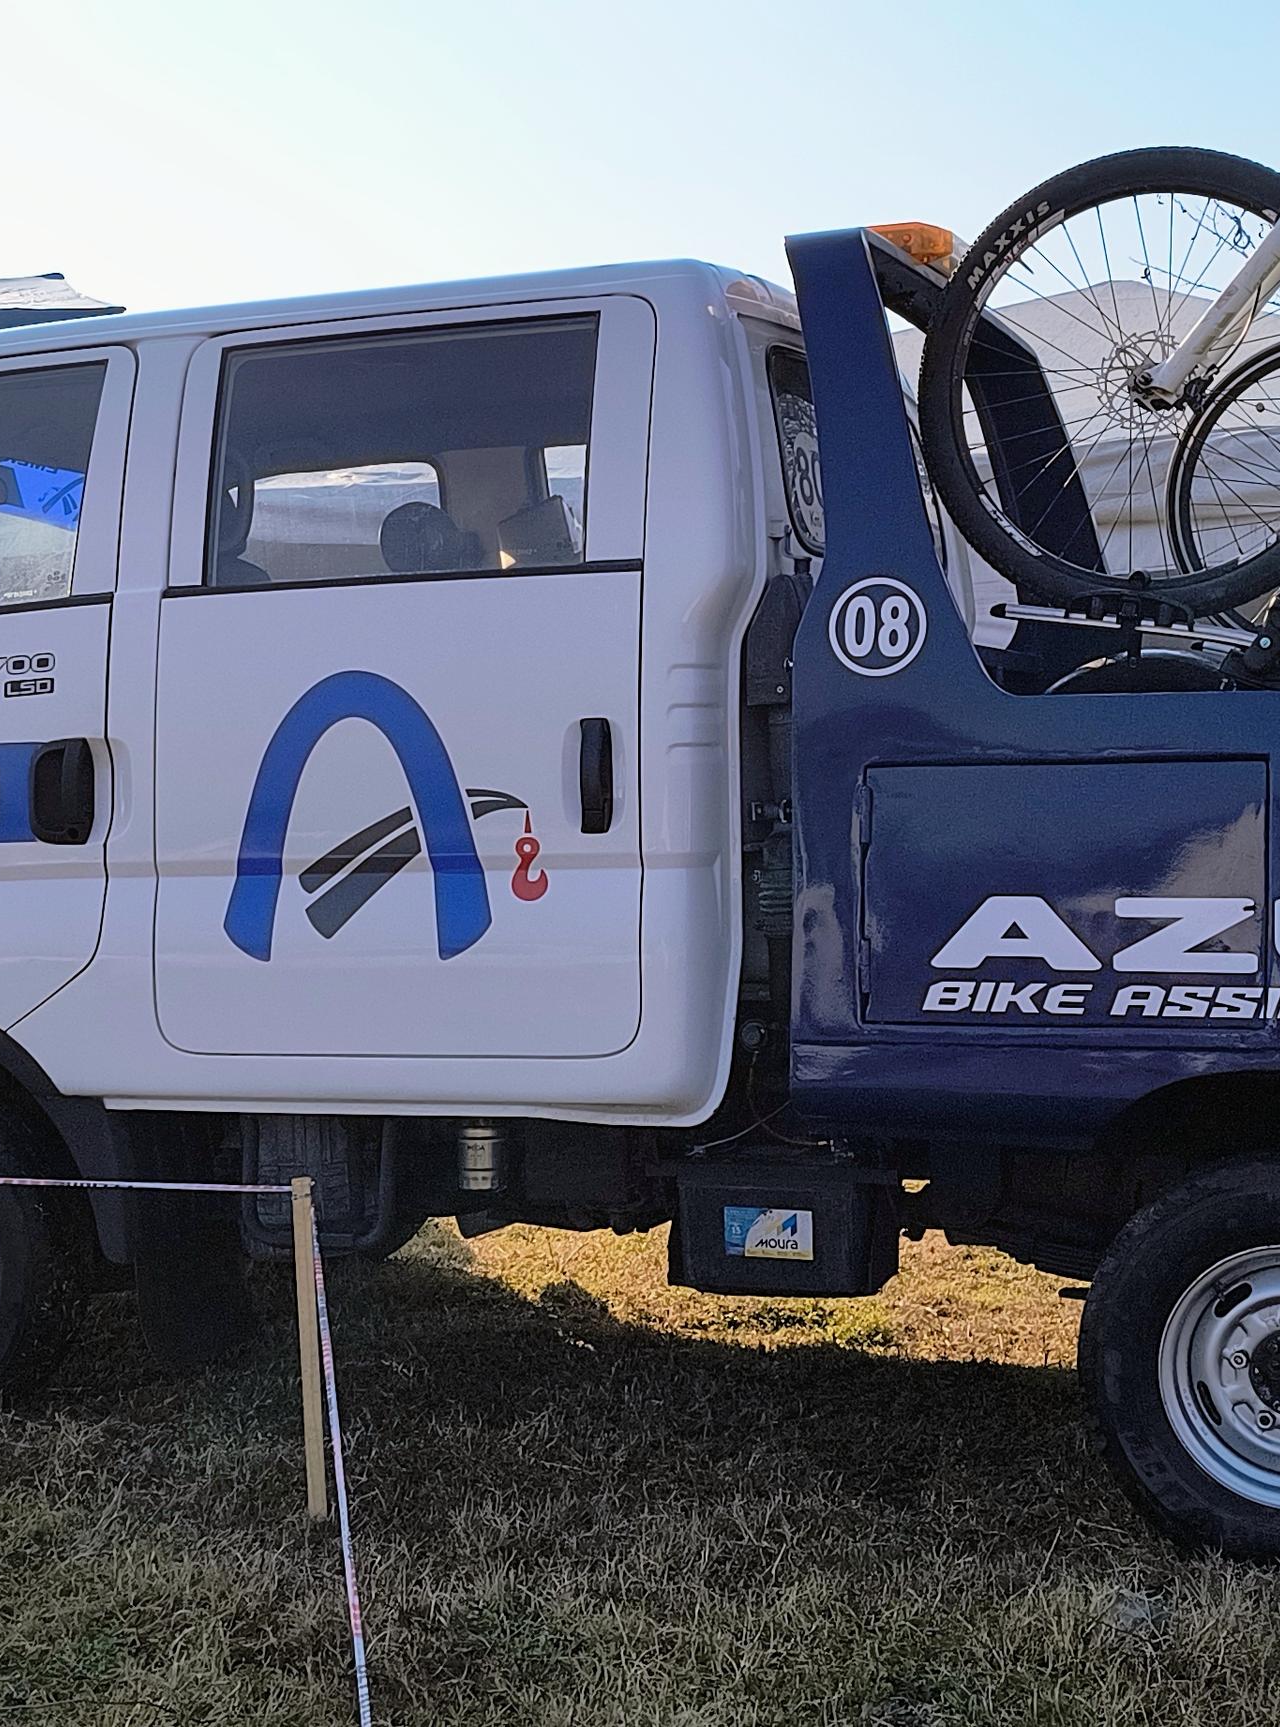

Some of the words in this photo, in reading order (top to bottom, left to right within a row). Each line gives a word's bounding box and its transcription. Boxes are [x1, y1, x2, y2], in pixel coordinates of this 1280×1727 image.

[967, 201, 1050, 290] MAXXIS
[844, 595, 910, 657] 08
[6, 679, 53, 697] LSD
[922, 981, 1094, 1015] BIKE
